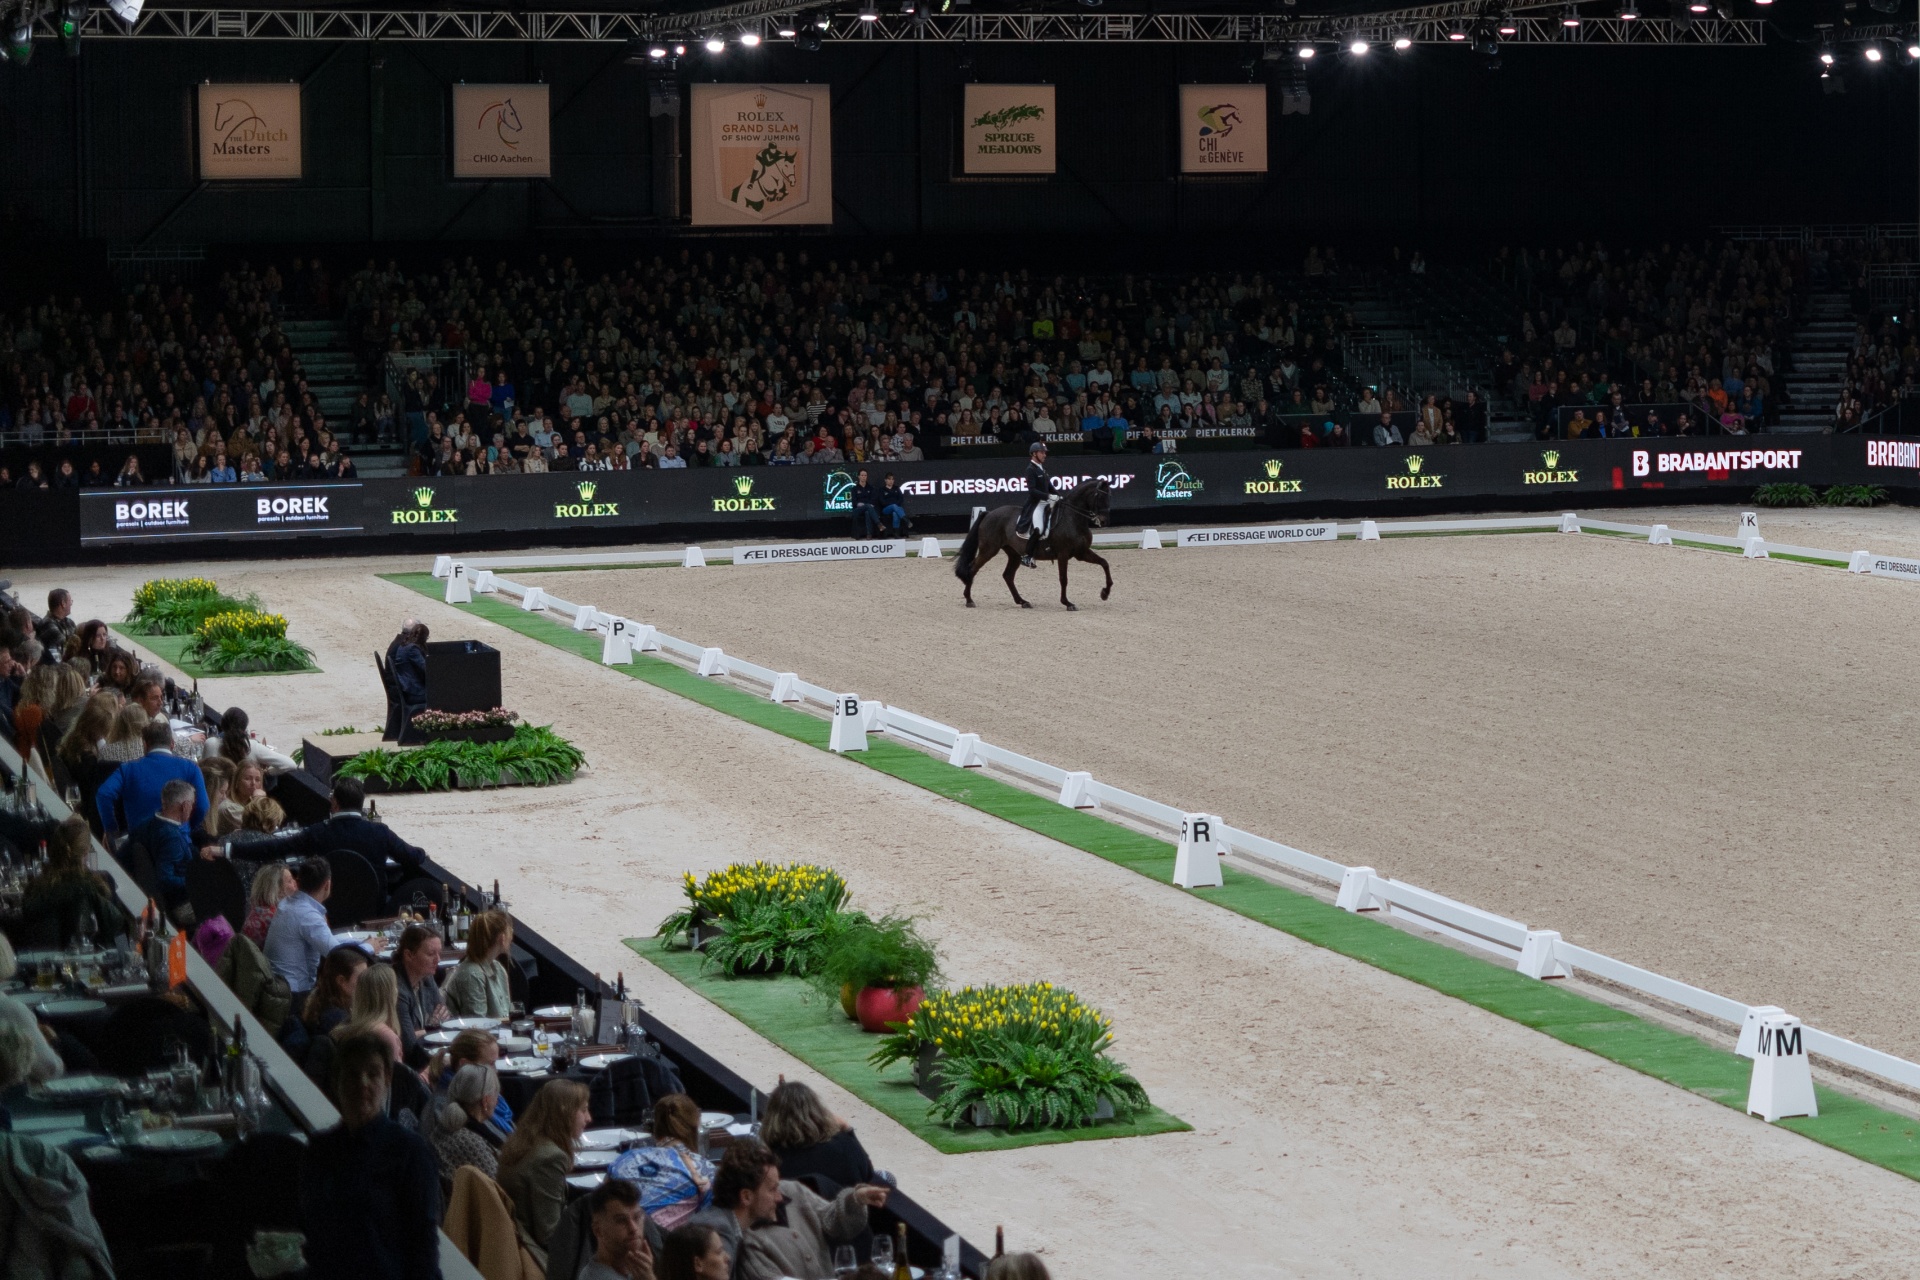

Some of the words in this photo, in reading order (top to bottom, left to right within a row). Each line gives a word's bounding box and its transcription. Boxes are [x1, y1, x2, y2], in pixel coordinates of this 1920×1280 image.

[737, 111, 784, 121] ROLEX
[243, 128, 288, 142] Dutch
[722, 124, 764, 133] GRAND
[767, 124, 799, 133] SLAM
[213, 142, 271, 155] Masters
[977, 144, 1042, 154] MEADOWS
[1199, 137, 1218, 152] CHI
[473, 154, 498, 163] CHIO
[500, 154, 533, 163] Aachen
[1199, 154, 1208, 164] DE
[1208, 149, 1244, 163] GENÈVE
[1046, 432, 1084, 442] KLERKX
[1196, 428, 1217, 437] PIET
[1219, 427, 1256, 437] KLERKX
[951, 436, 973, 445] PIET
[1658, 450, 1802, 472] BRABANTSPORT
[1386, 475, 1443, 489] ROLEX
[1524, 470, 1579, 484] ROLEX
[941, 477, 1029, 494] DRESSAGE
[1175, 480, 1203, 490] Dutch
[1244, 480, 1303, 494] ROLEX
[1156, 489, 1193, 499] Masters
[115, 501, 189, 520] BOREK
[257, 496, 329, 515] BOREK
[555, 503, 620, 518] ROLEX
[713, 498, 776, 512] ROLEX
[391, 509, 458, 524] ROLEX
[1747, 515, 1756, 527] K
[1187, 533, 1210, 542] FEI
[1212, 530, 1266, 542] DRESSAGE
[1267, 528, 1304, 539] WORLD
[1305, 527, 1326, 537] CUP
[743, 550, 768, 560] FEI
[771, 546, 829, 559] DRESSAGE
[830, 544, 869, 556] WORLD
[871, 543, 894, 554] CUP
[454, 566, 464, 578] F
[1888, 561, 1918, 575] DRESSAGE
[613, 621, 625, 636] P
[844, 699, 859, 717] B
[1181, 820, 1188, 843] R
[1193, 821, 1211, 843] R
[1757, 1025, 1773, 1057] M
[1775, 1026, 1803, 1057] M
